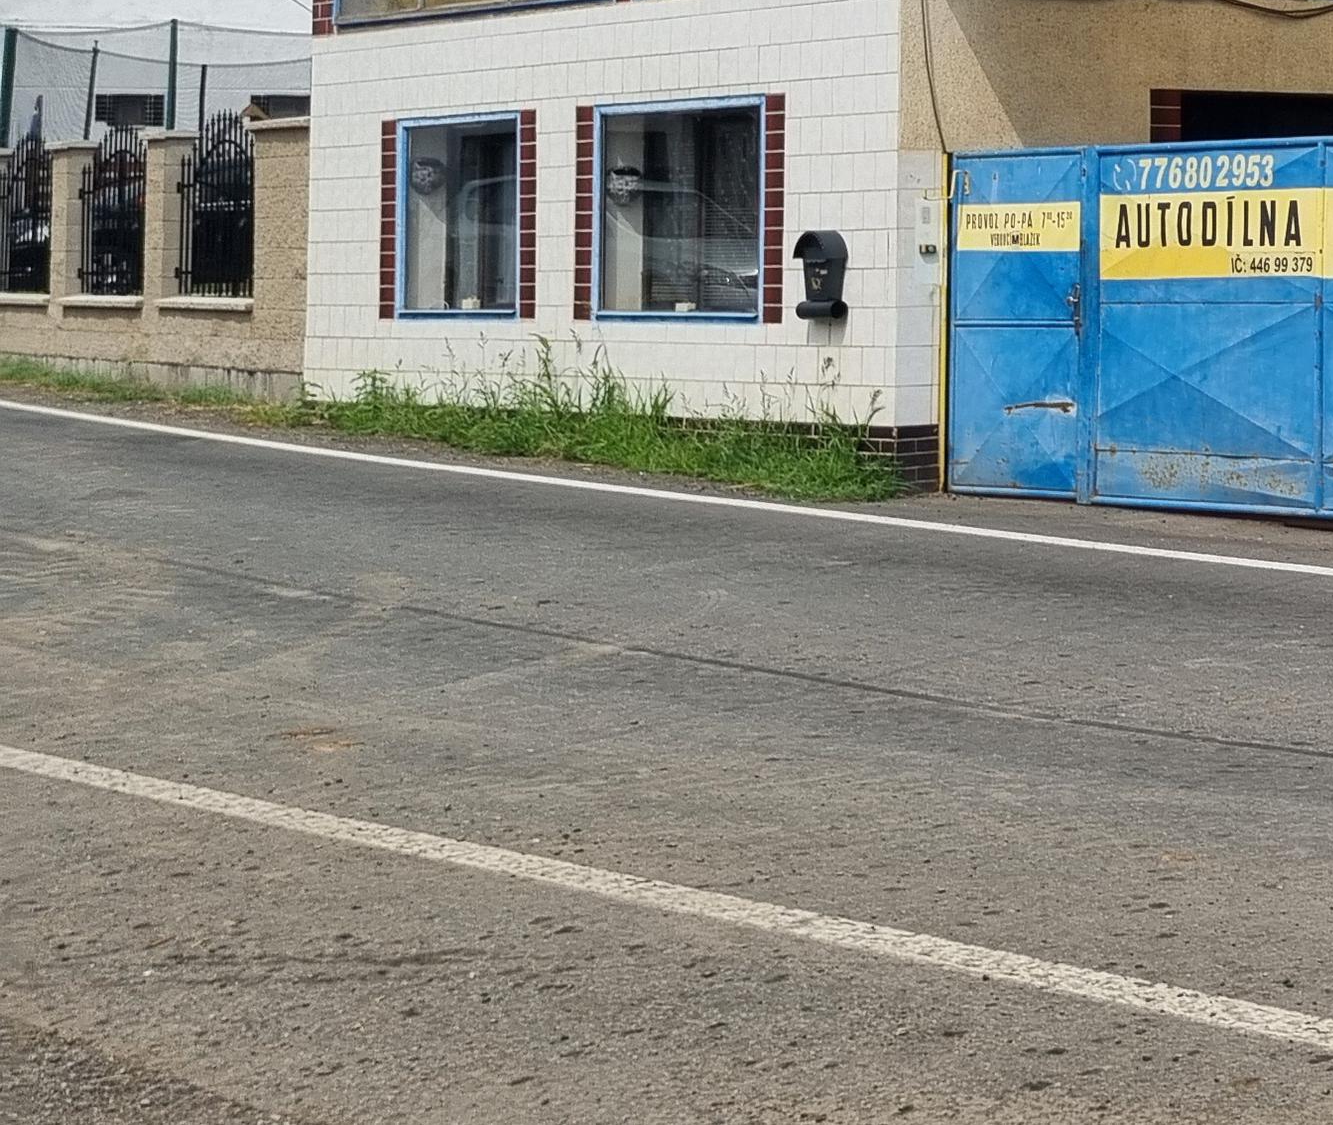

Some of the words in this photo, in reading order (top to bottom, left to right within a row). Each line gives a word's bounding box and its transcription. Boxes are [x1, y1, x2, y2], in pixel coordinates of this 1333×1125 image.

[1138, 154, 1275, 190] 776802953
[965, 212, 999, 230] PROVOZ
[1003, 211, 1033, 229] PO-PÁ
[1115, 196, 1302, 249] AUTODÍLNA
[1019, 232, 1041, 246] BLAŽEK
[1231, 253, 1247, 273] IČ:
[1249, 256, 1270, 273] 446
[1274, 256, 1288, 273] 99
[1291, 256, 1313, 273] 379
